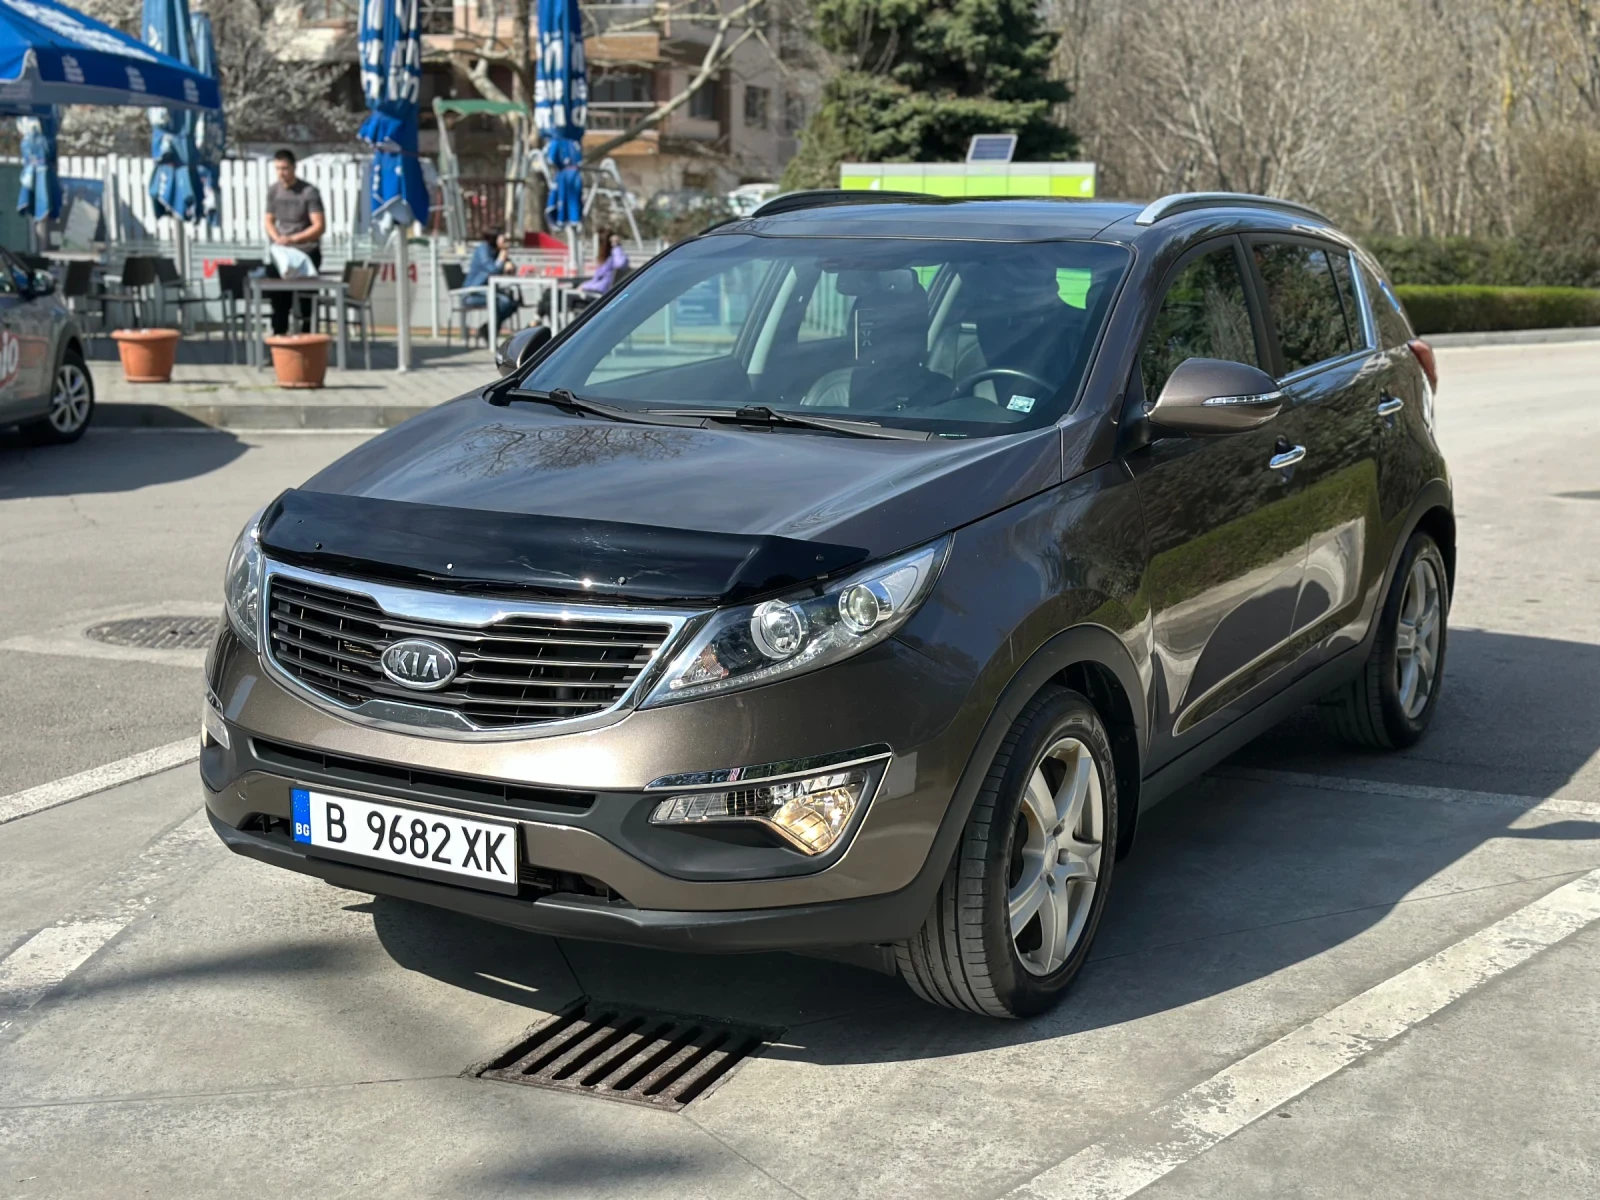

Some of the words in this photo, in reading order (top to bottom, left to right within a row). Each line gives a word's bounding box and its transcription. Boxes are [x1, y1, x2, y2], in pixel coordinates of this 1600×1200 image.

[0, 331, 19, 379] io
[388, 649, 440, 679] KIA
[295, 822, 310, 837] BG
[326, 801, 347, 843] B
[366, 810, 452, 865] 9682
[461, 825, 508, 875] XK
